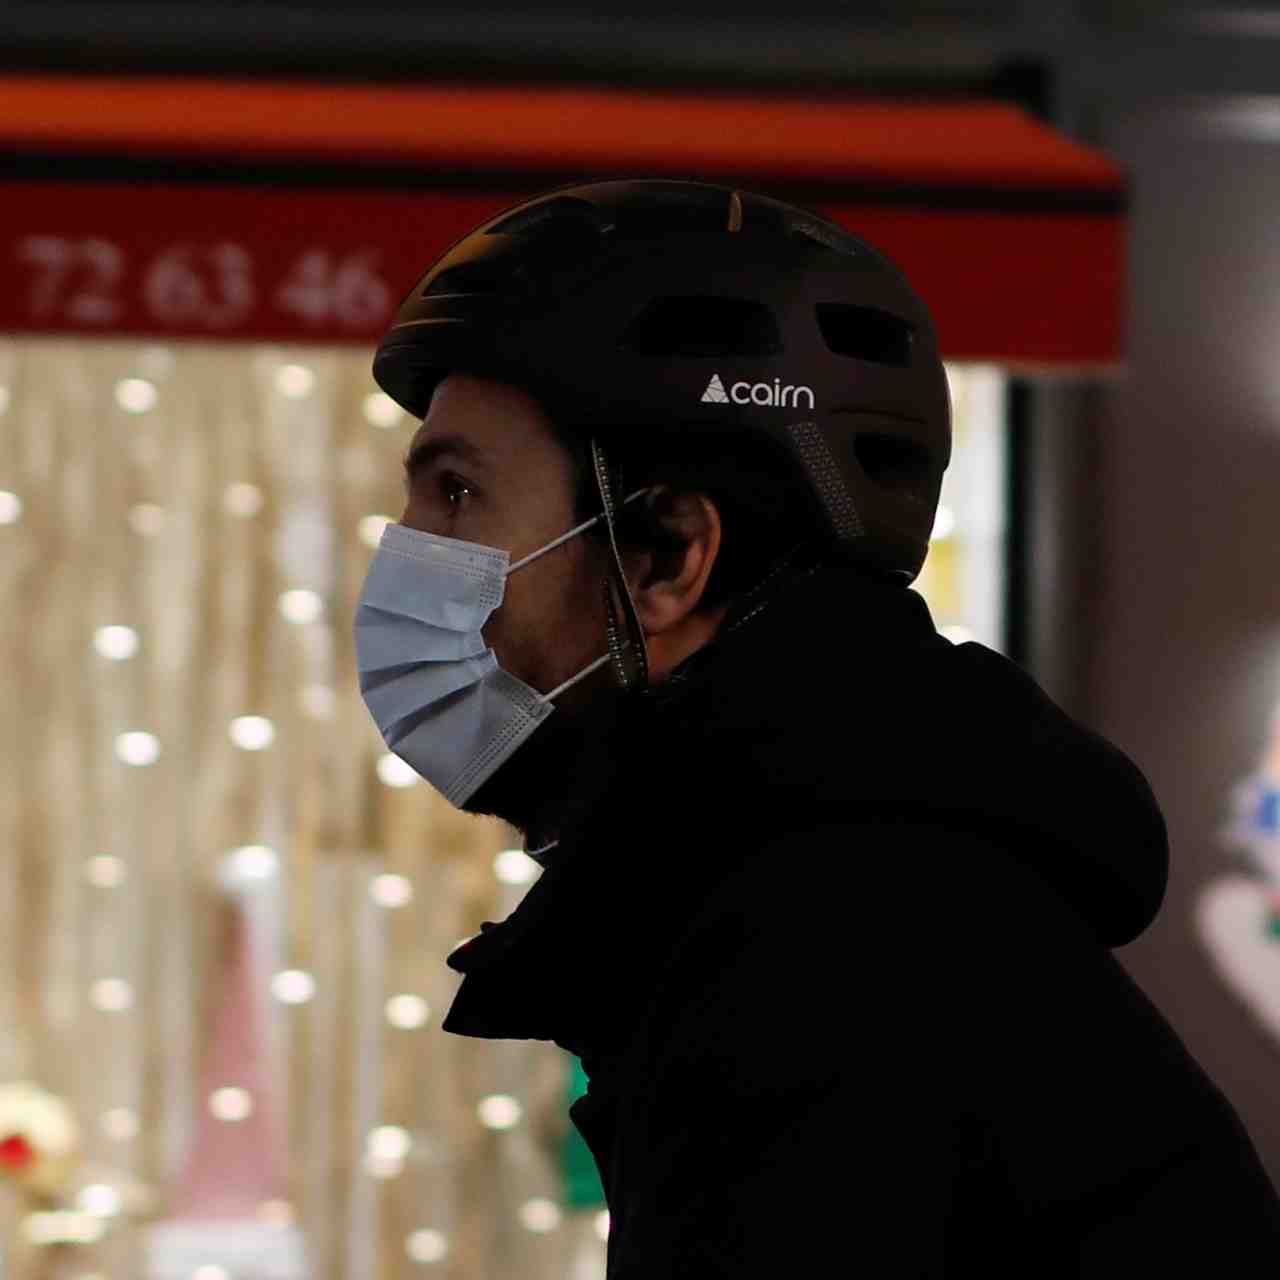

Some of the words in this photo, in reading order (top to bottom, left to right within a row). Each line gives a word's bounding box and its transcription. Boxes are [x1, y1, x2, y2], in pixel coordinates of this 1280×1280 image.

[17, 236, 123, 324] 72
[143, 241, 255, 329] 63
[276, 246, 393, 331] 46
[730, 377, 815, 409] cairn
